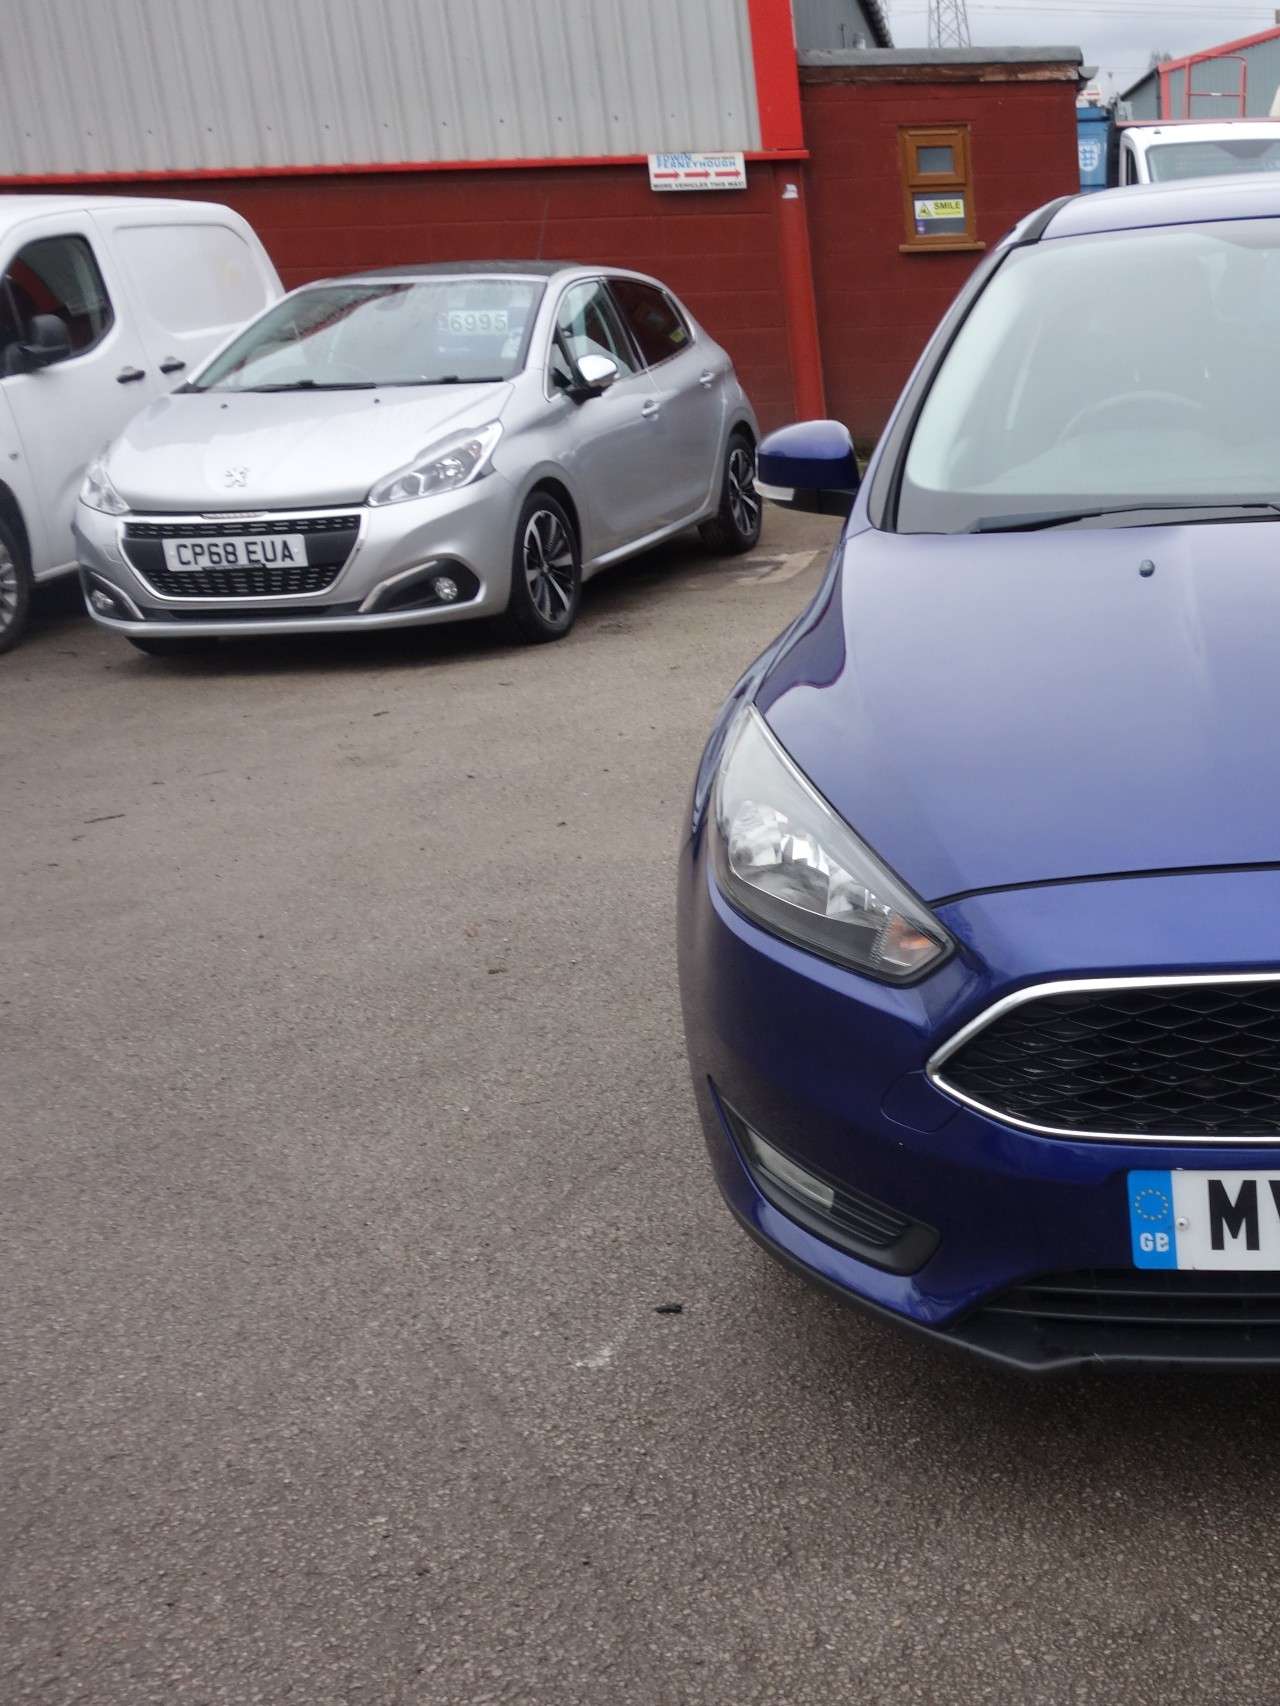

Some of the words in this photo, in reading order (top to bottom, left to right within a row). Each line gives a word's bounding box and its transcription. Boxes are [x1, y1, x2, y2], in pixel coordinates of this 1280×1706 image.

[934, 201, 961, 209] SMILE
[176, 543, 238, 565] CP68
[244, 540, 295, 563] EUA
[1140, 1232, 1169, 1252] GB
